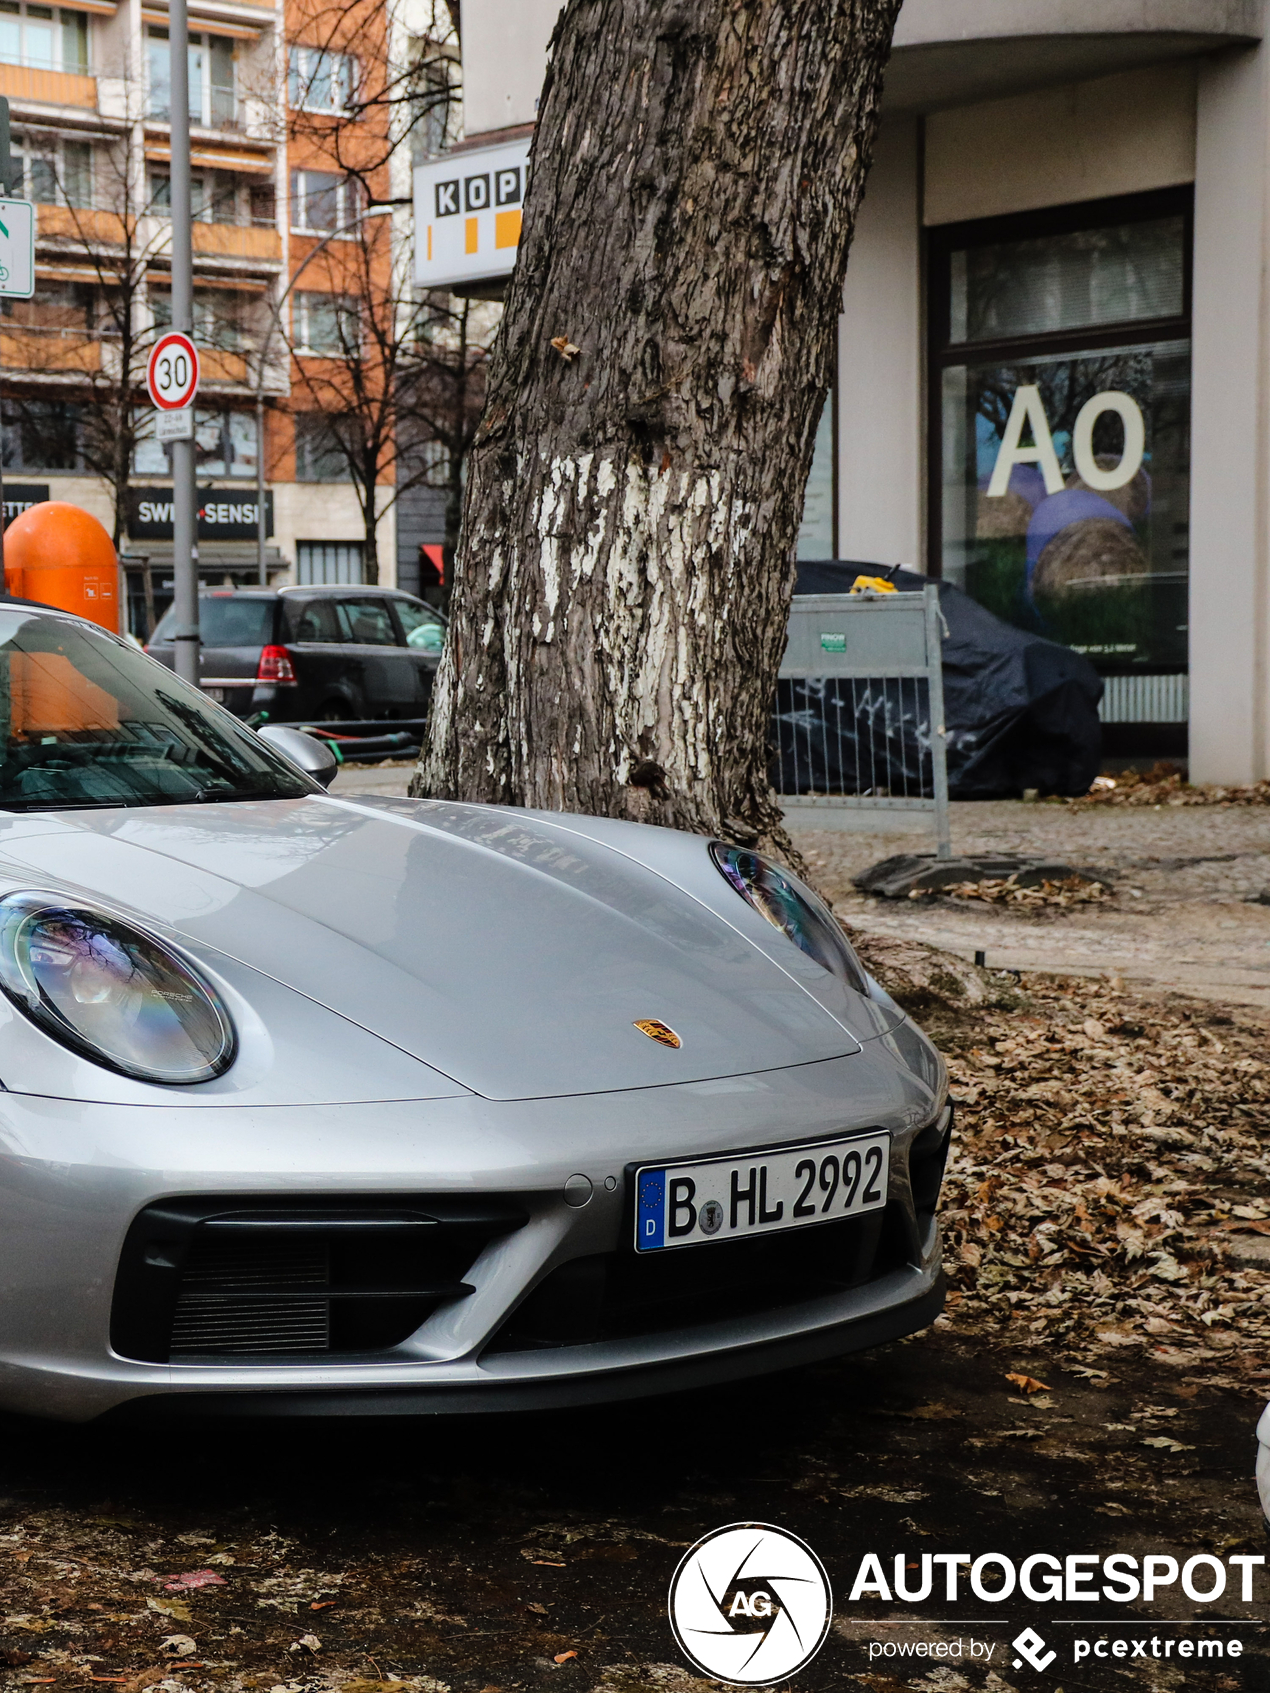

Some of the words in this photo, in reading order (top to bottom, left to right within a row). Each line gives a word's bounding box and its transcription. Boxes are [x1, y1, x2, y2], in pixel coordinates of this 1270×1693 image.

[159, 355, 188, 391] 30
[668, 1177, 697, 1238] B
[730, 1165, 784, 1229] HL
[793, 1146, 884, 1219] 2992
[645, 1219, 656, 1236] D
